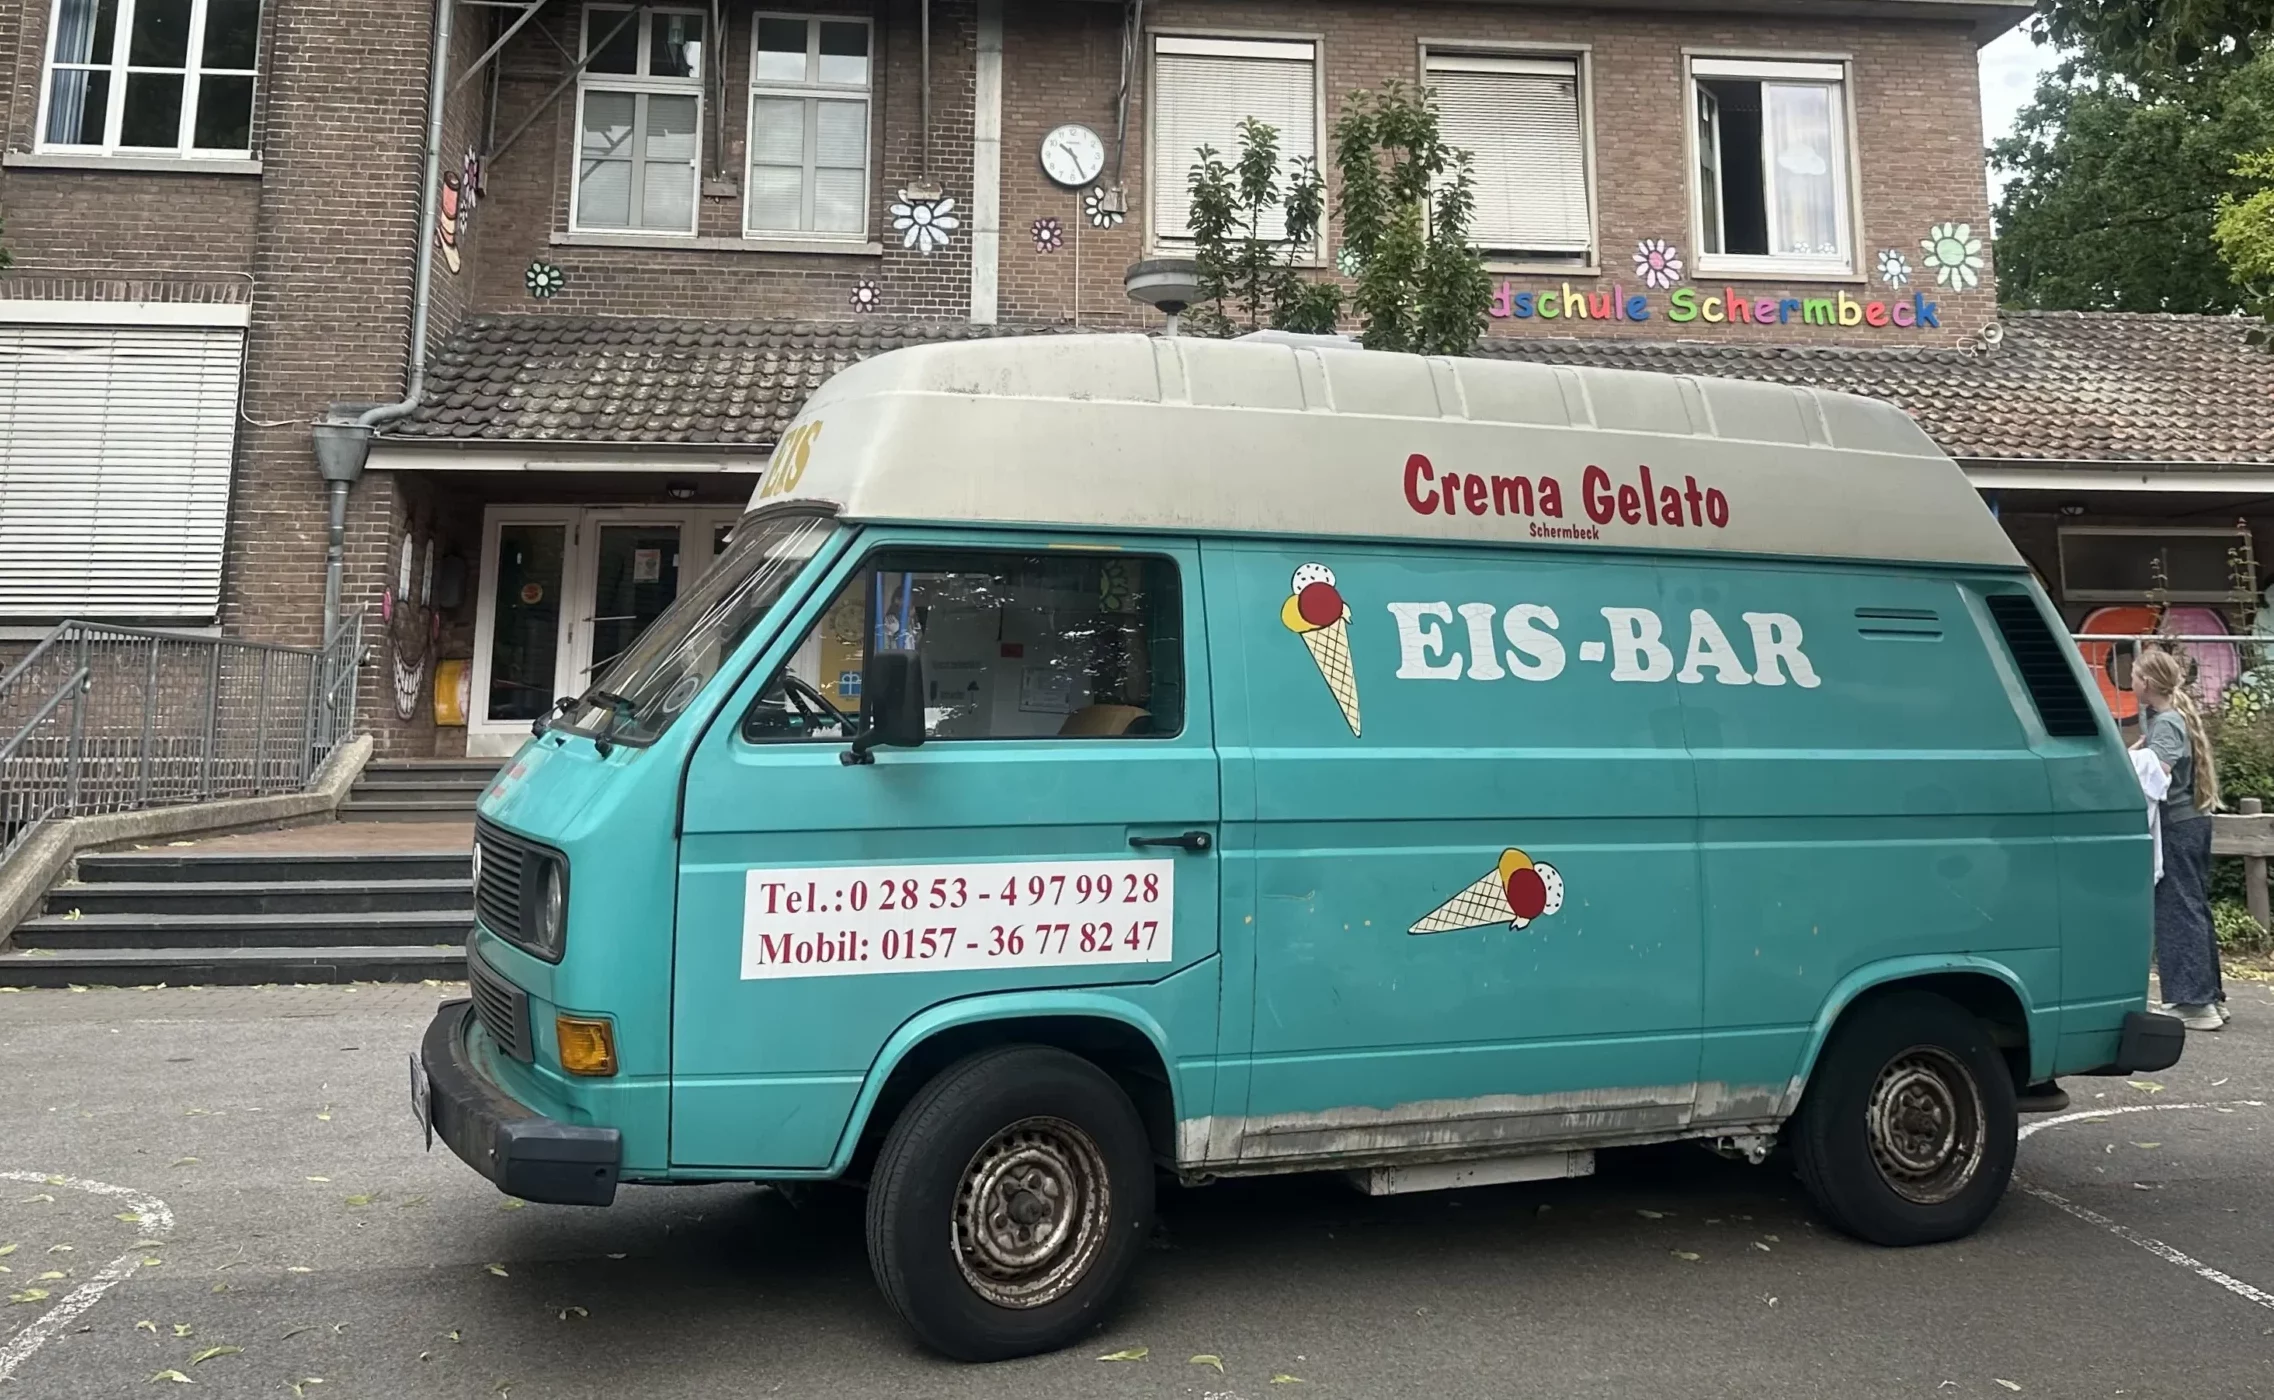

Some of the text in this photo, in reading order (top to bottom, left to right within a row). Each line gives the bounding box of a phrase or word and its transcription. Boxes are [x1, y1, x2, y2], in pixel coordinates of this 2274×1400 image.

[1489, 281, 1940, 328] dschule Schermbeck
[759, 420, 823, 499] EIS
[1404, 453, 1729, 528] Crema Gelato
[1529, 521, 1599, 540] Schermbeck
[757, 930, 869, 966] Mobil:
[882, 927, 957, 960] 0157
[987, 924, 1024, 956] 36
[1035, 923, 1070, 955] 77
[1079, 921, 1113, 953] 82
[1123, 920, 1159, 951] 47
